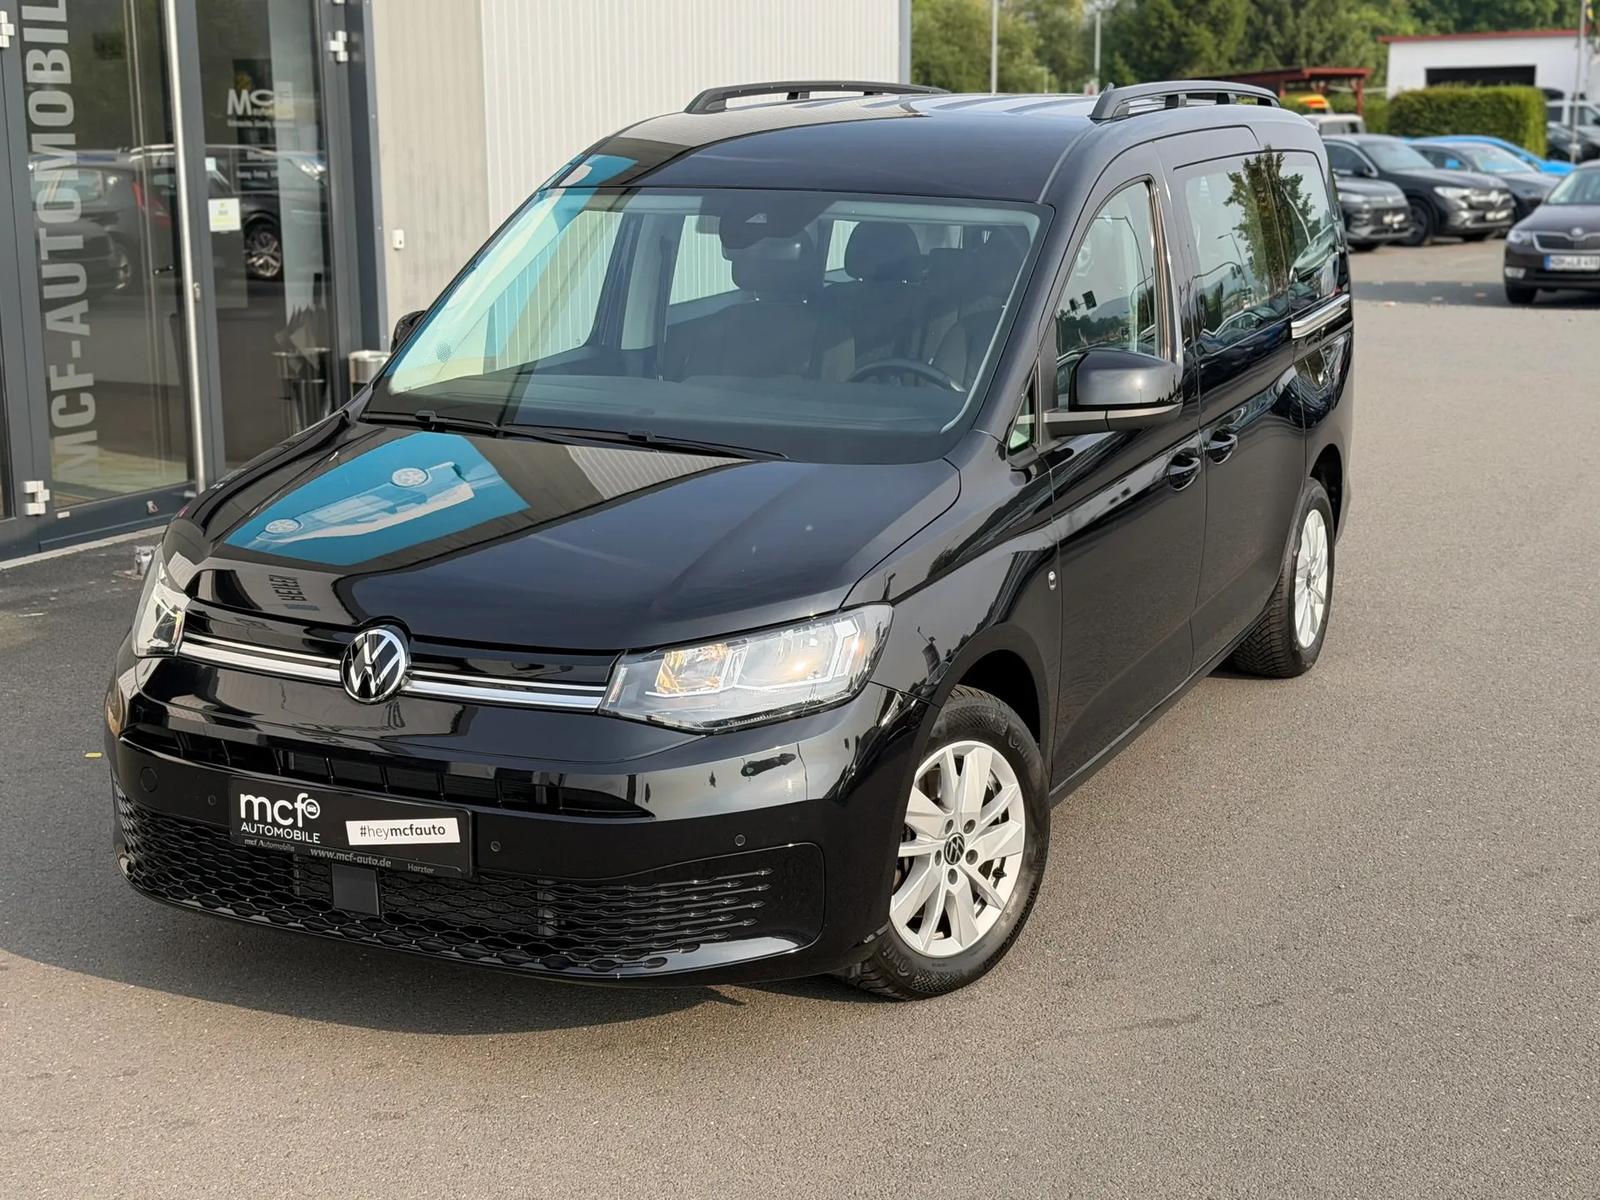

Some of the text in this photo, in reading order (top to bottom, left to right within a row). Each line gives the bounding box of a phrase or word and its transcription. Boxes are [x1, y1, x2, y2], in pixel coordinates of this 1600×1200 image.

[240, 793, 310, 828] mcf
[241, 822, 320, 844] AUTOMOBILE
[360, 823, 447, 841] #heymcfauto
[310, 847, 391, 868] www.mcf-auto.de
